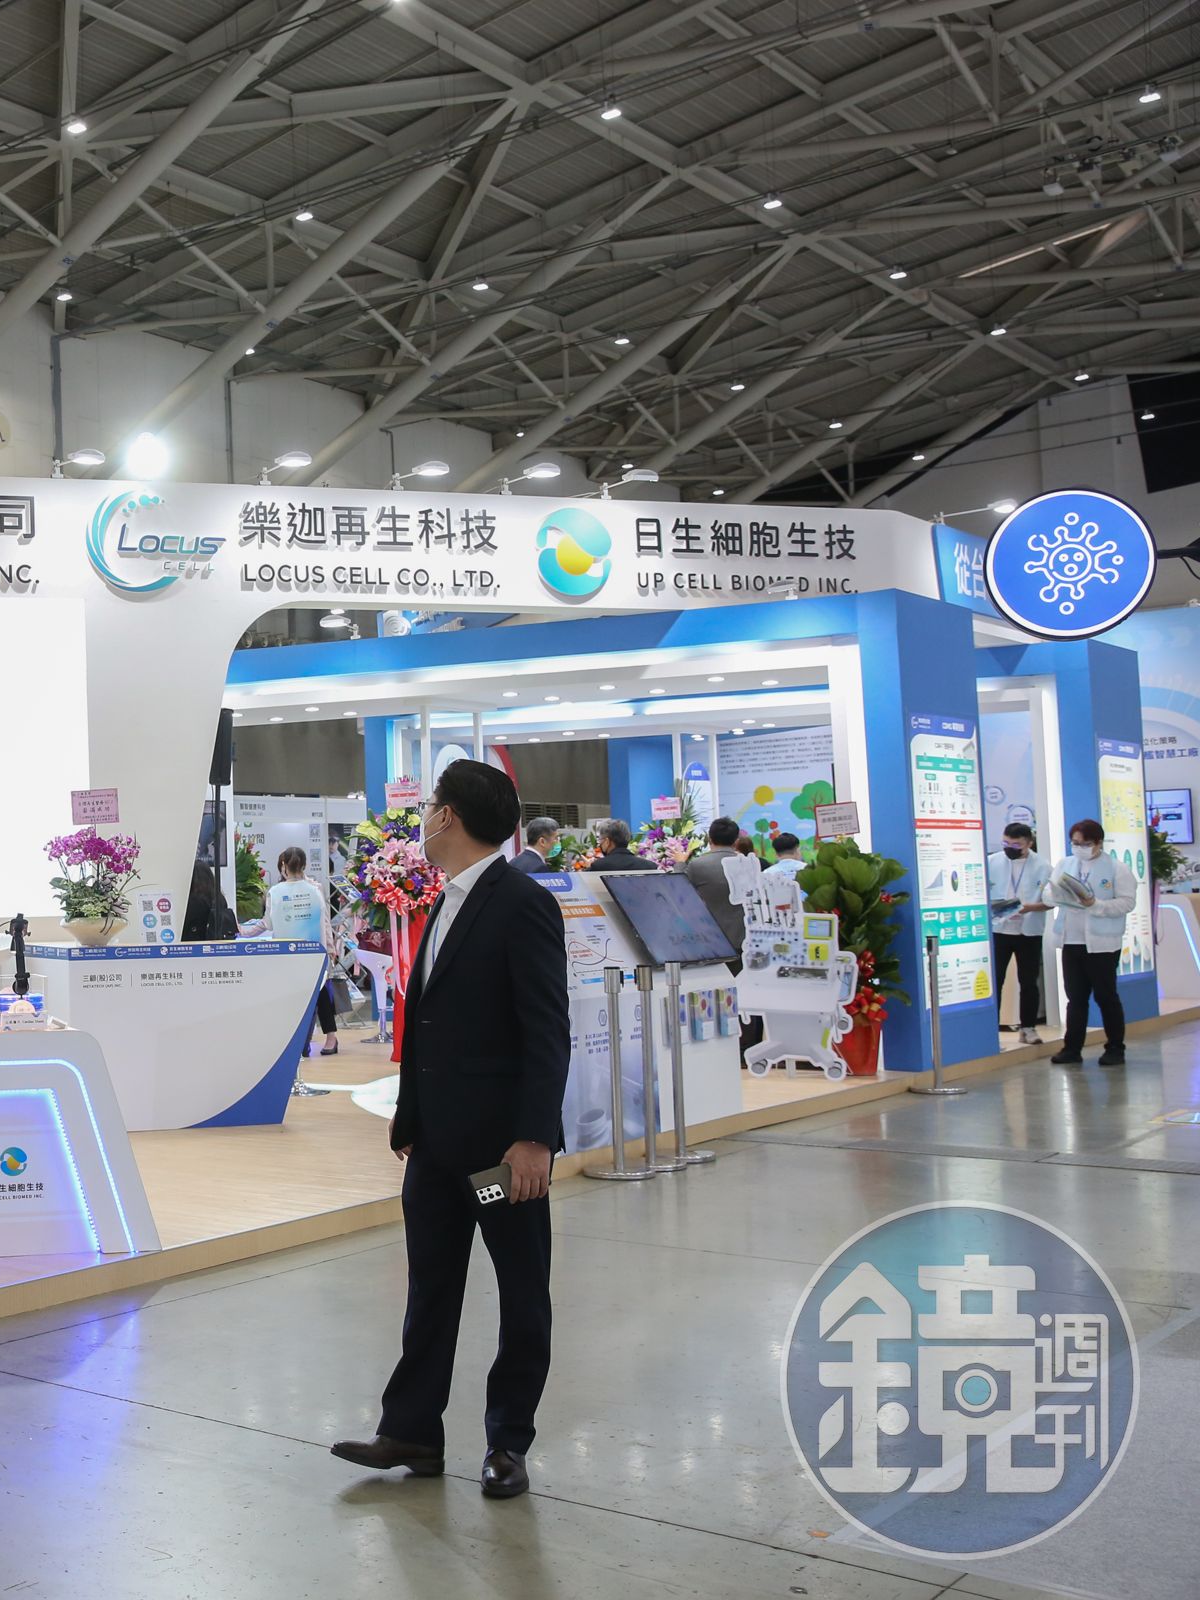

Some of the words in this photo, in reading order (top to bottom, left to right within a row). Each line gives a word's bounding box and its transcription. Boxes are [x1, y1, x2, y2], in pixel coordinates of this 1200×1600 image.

[242, 502, 499, 550] 樂迦再生科技
[635, 517, 856, 560] 日生細胞生技
[163, 561, 215, 571] CELL
[244, 564, 325, 584] LOCUS
[333, 566, 390, 586] CELL
[398, 568, 444, 590] CO.,
[453, 570, 501, 588] LTD.
[638, 572, 665, 588] UP
[674, 573, 722, 590] CELL
[731, 575, 809, 592] BIOD
[818, 577, 858, 593] INC.
